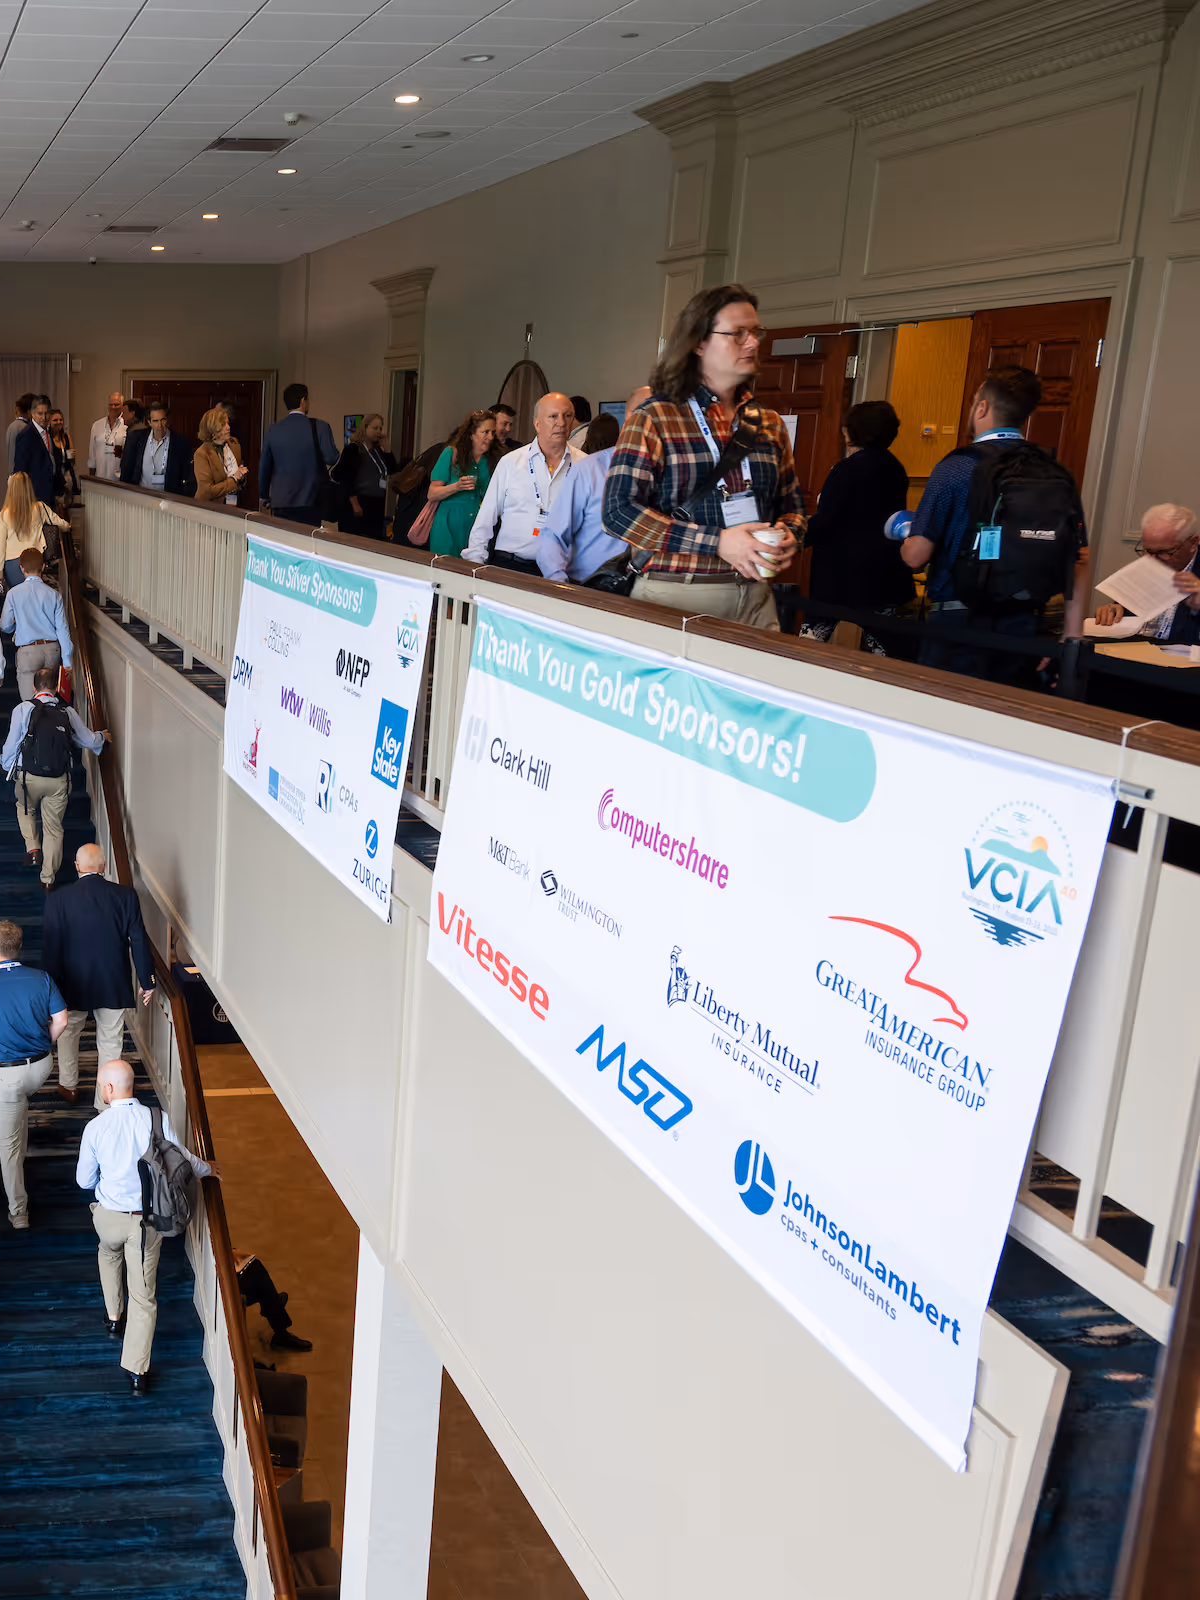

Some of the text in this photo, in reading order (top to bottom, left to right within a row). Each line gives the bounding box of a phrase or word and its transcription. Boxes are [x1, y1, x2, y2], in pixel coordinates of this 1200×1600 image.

[248, 549, 364, 614] Thank You Silver Sponsors!
[345, 648, 371, 688] NFP
[396, 625, 419, 654] VCIA
[281, 685, 304, 718] wtw
[477, 622, 806, 783] Thank You Gold Sponsors!
[373, 747, 398, 785] State
[382, 726, 401, 763] Key
[490, 737, 551, 791] Clark Hill
[597, 788, 729, 889] Computershare
[353, 858, 388, 904] ZURICH
[557, 900, 579, 922] TRUST
[559, 884, 623, 939] WILMINGTON
[963, 847, 1063, 925] VCIA
[438, 891, 550, 1021] Vitesse
[692, 980, 819, 1087] Liberty Mutual
[711, 1032, 782, 1094] INSURANCE
[865, 1029, 986, 1112] INSURANCE GROUP
[781, 1213, 808, 1244] cpas
[821, 1248, 897, 1321] consultants
[783, 1179, 961, 1346] JohnsonLambert
